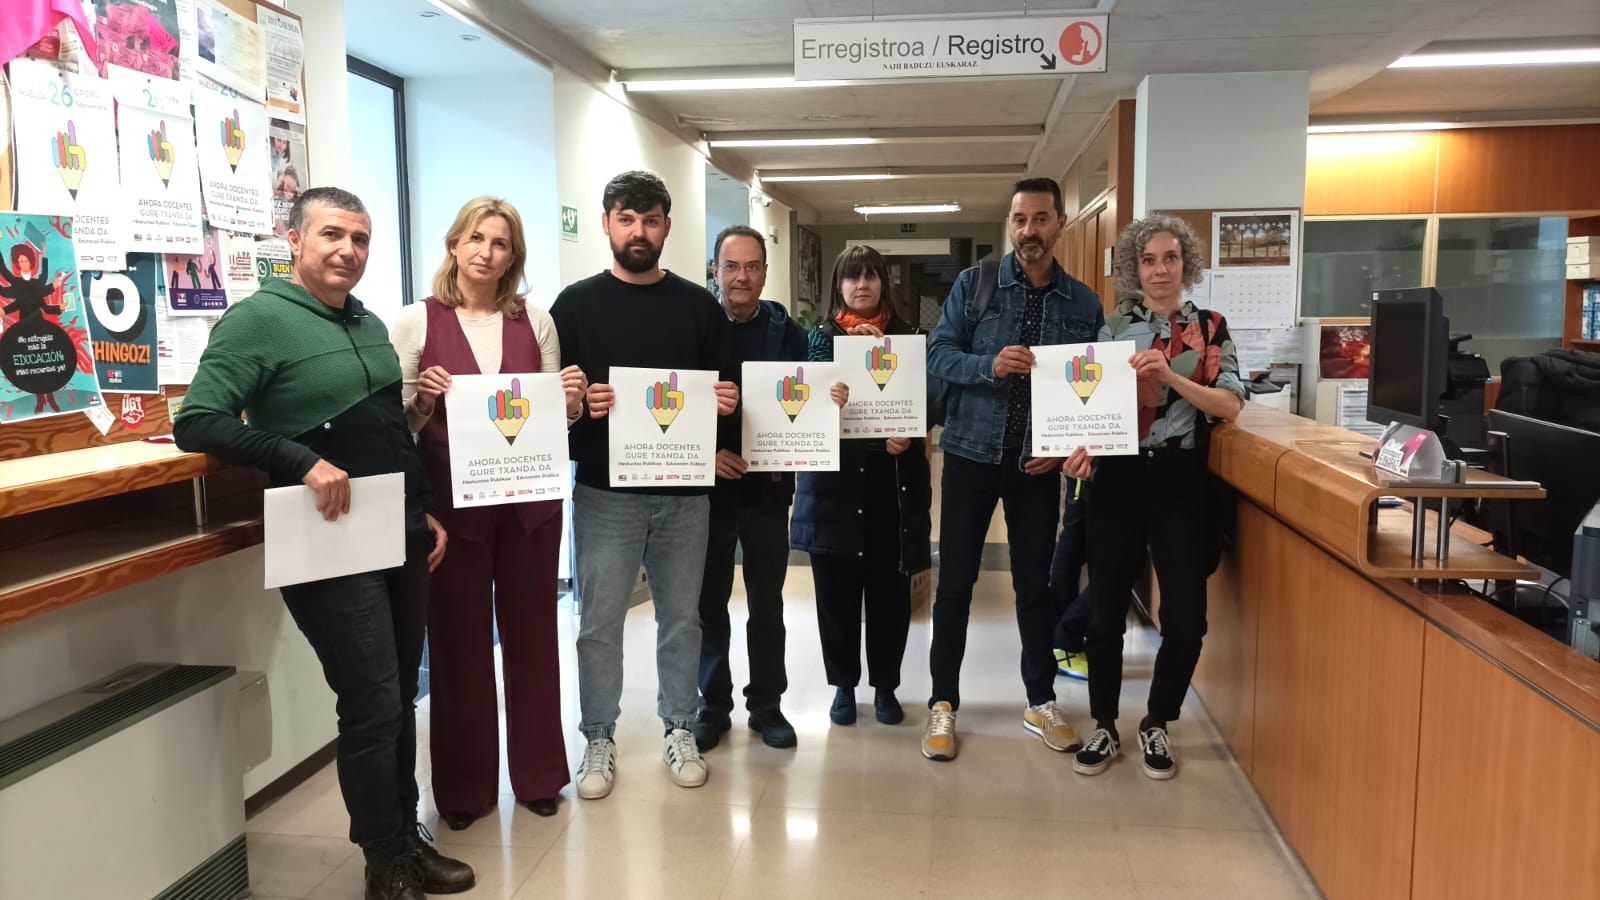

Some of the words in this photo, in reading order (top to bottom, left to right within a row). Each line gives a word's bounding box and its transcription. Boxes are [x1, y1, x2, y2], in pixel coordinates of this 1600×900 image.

[802, 38, 925, 64] Erregistroa
[932, 35, 940, 57] /
[948, 34, 1044, 60] Registro
[882, 63, 902, 71] NAHI
[903, 62, 934, 70] BADUZU
[936, 60, 978, 69] EUSKARAZ
[49, 81, 73, 108] 26
[75, 215, 109, 224] OCENTES
[74, 227, 95, 236] ANDA
[92, 341, 151, 364] HINGOZ!
[122, 395, 142, 412] UGT
[468, 458, 501, 467] AHORA
[504, 454, 552, 464] DOCENTES
[470, 468, 495, 476] GURE
[499, 465, 536, 474] TXANDA
